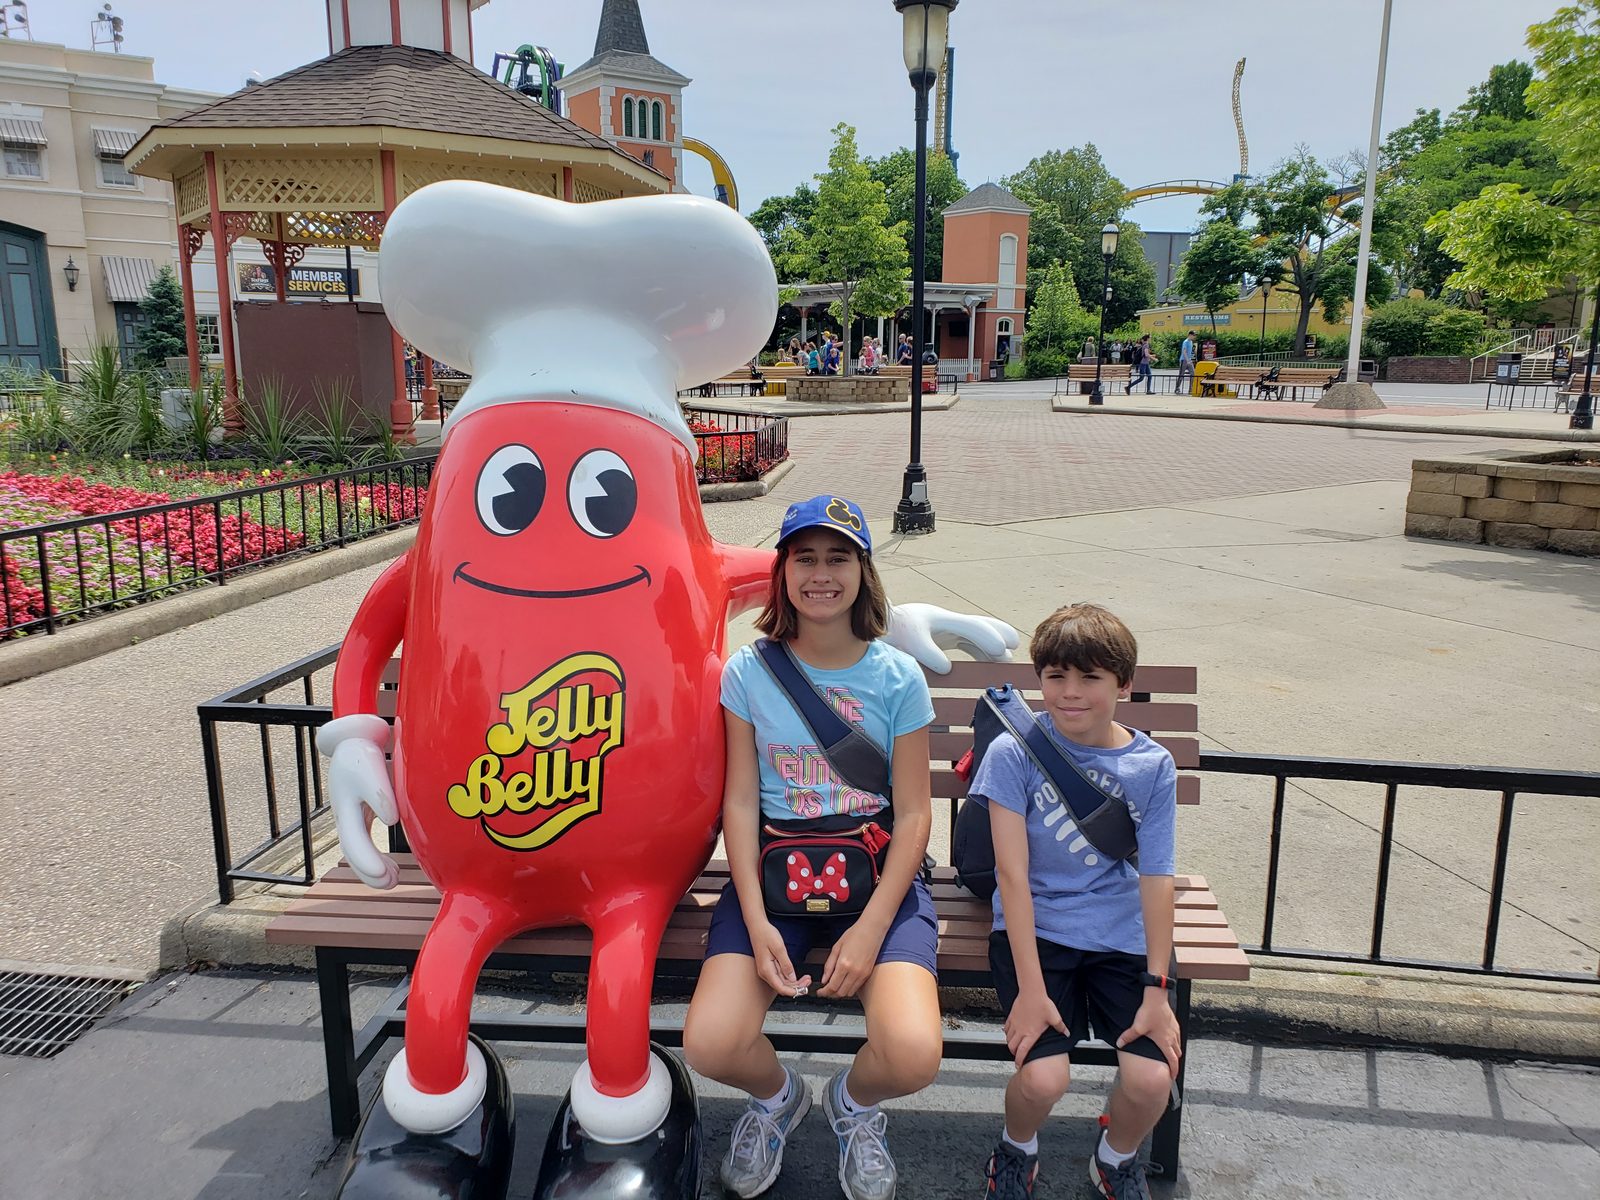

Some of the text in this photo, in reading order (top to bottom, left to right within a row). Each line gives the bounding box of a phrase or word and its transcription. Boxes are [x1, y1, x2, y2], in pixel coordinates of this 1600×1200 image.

[288, 280, 346, 293] SERVICES
[291, 270, 342, 282] MEMBER
[486, 651, 626, 757] Jelly
[447, 748, 603, 852] Belly
